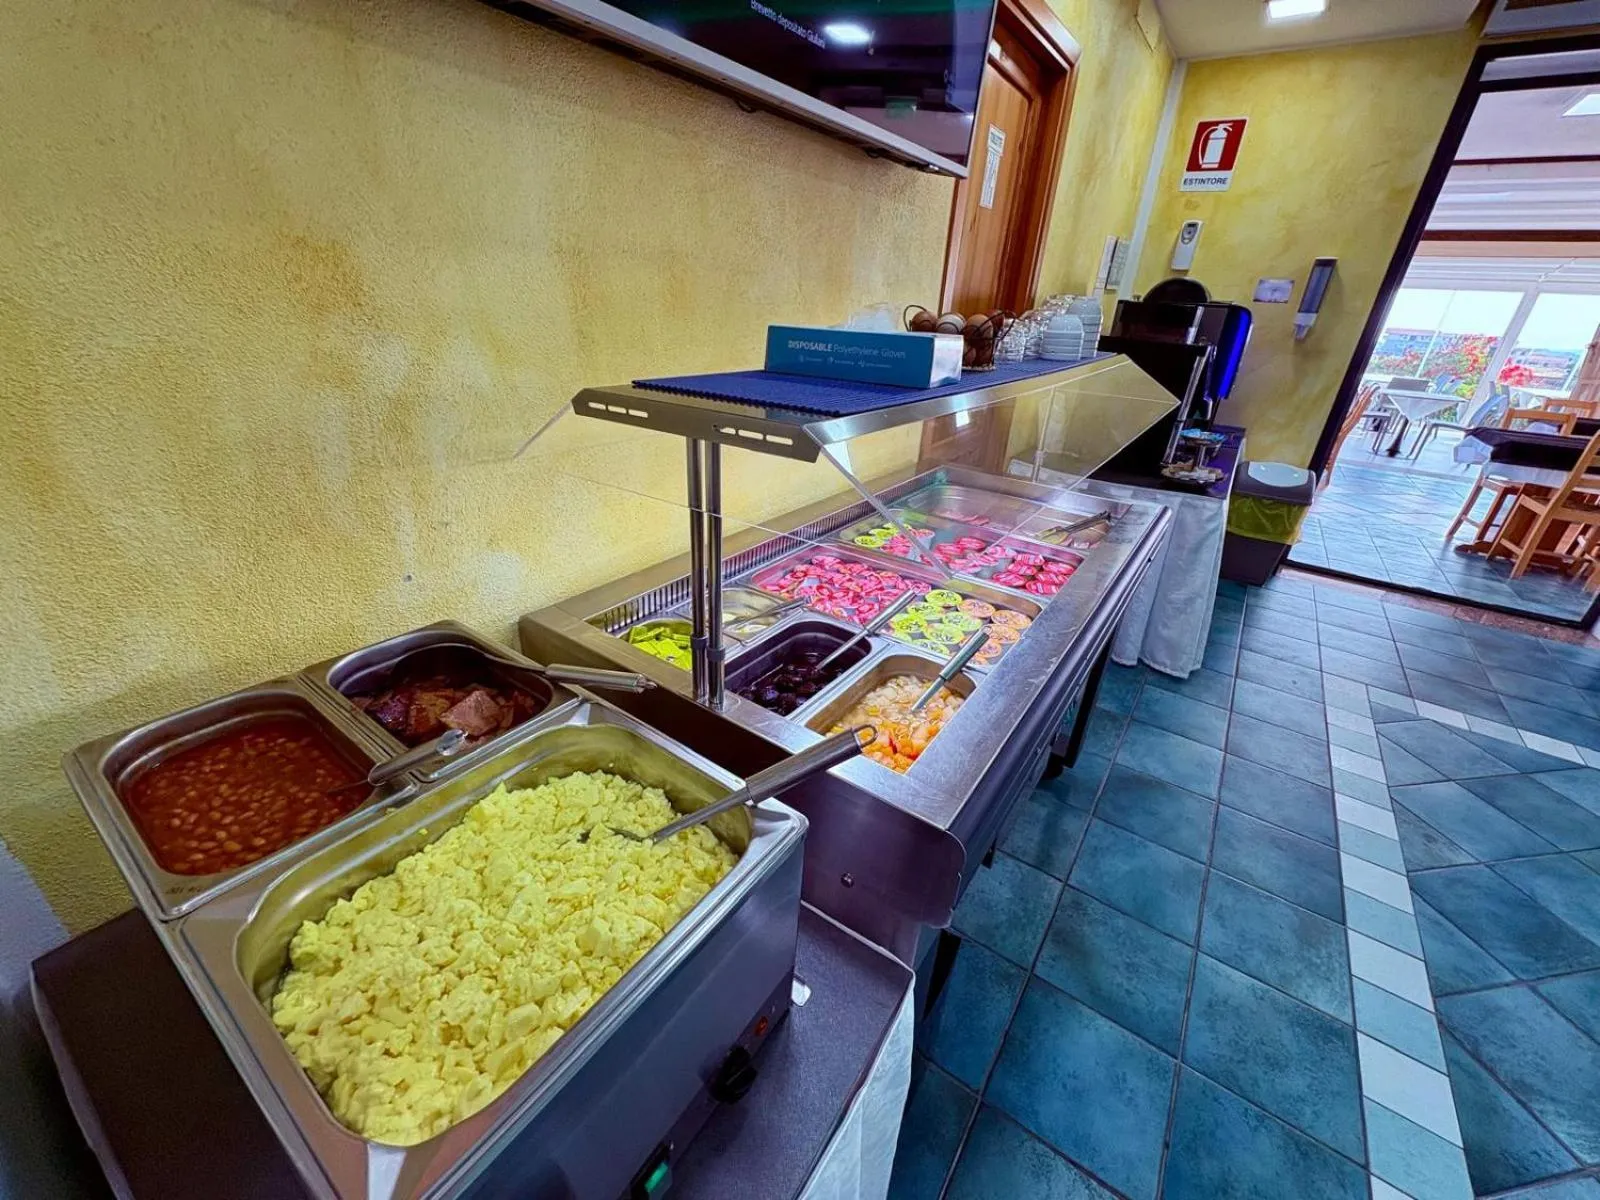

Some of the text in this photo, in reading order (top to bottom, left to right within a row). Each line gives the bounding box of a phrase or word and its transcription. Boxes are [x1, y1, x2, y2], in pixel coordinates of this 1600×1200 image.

[751, 0, 776, 21] Brevetto
[777, 12, 806, 38] depositato
[1183, 177, 1228, 186] ESTINTORE
[788, 340, 906, 359] DISPOSABLE Polyethylene Gloves
